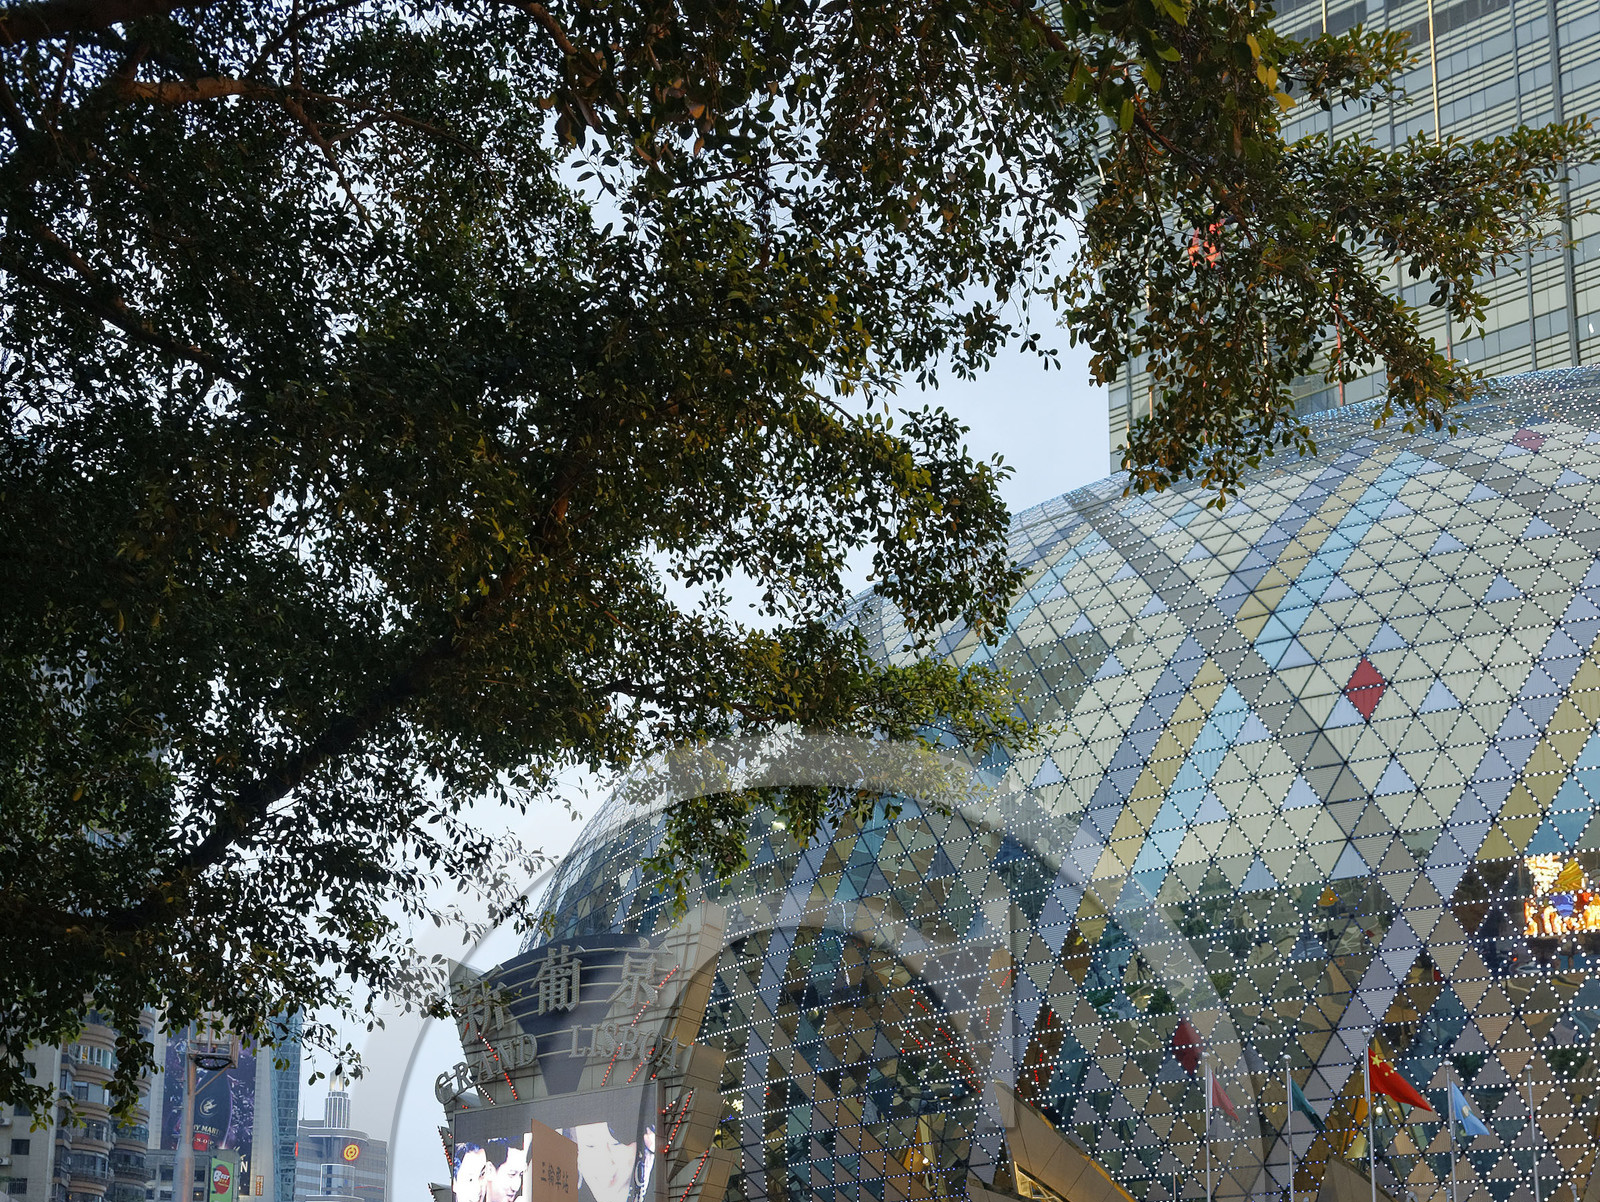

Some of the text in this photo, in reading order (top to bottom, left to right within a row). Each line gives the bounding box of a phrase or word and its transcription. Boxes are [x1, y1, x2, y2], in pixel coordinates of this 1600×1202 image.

[453, 937, 673, 1044] 新葡京
[434, 1022, 679, 1105] GRAND LISBOA
[540, 1162, 569, 1194] 三輪車站
